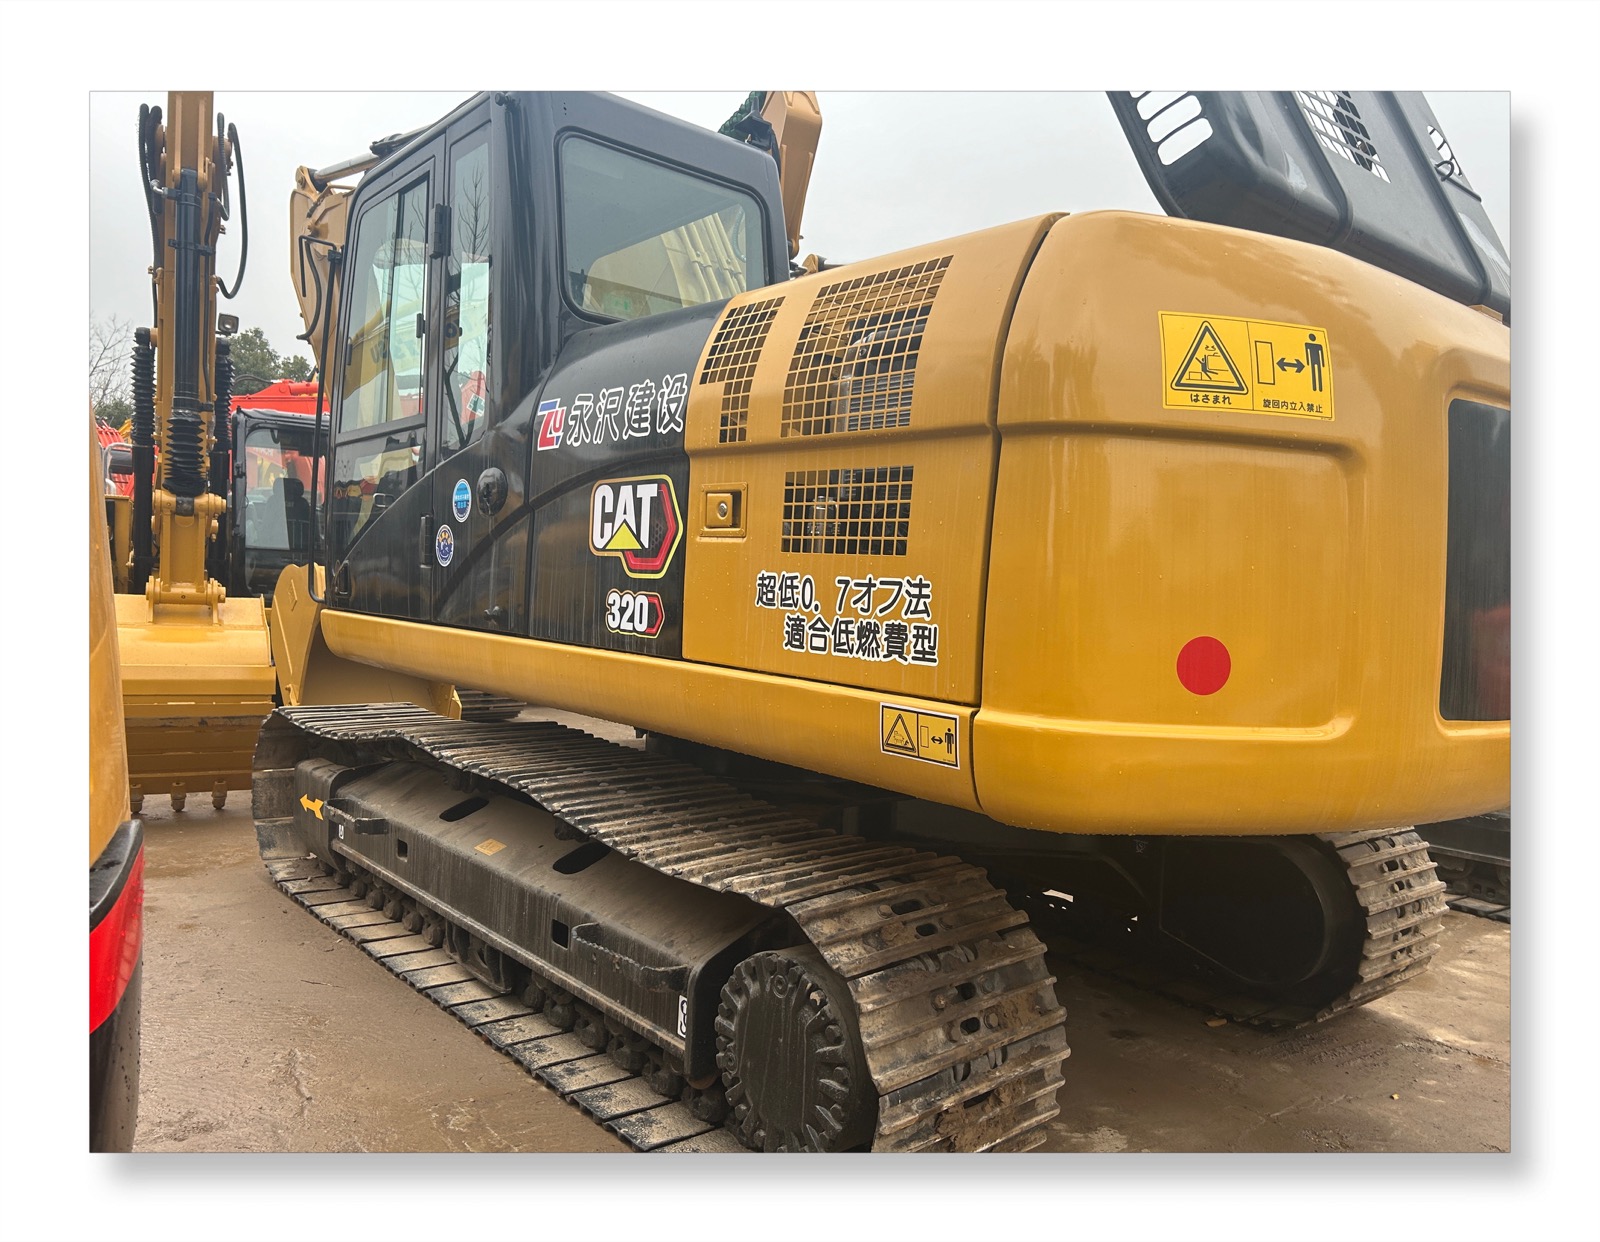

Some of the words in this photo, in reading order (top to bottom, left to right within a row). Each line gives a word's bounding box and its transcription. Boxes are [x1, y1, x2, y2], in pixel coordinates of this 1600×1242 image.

[1190, 393, 1232, 405] はさまれ
[1262, 398, 1324, 414] 旋回内立入禁止
[593, 483, 658, 550] CAT
[606, 591, 649, 632] 320
[783, 613, 939, 665] 適合低燃費型
